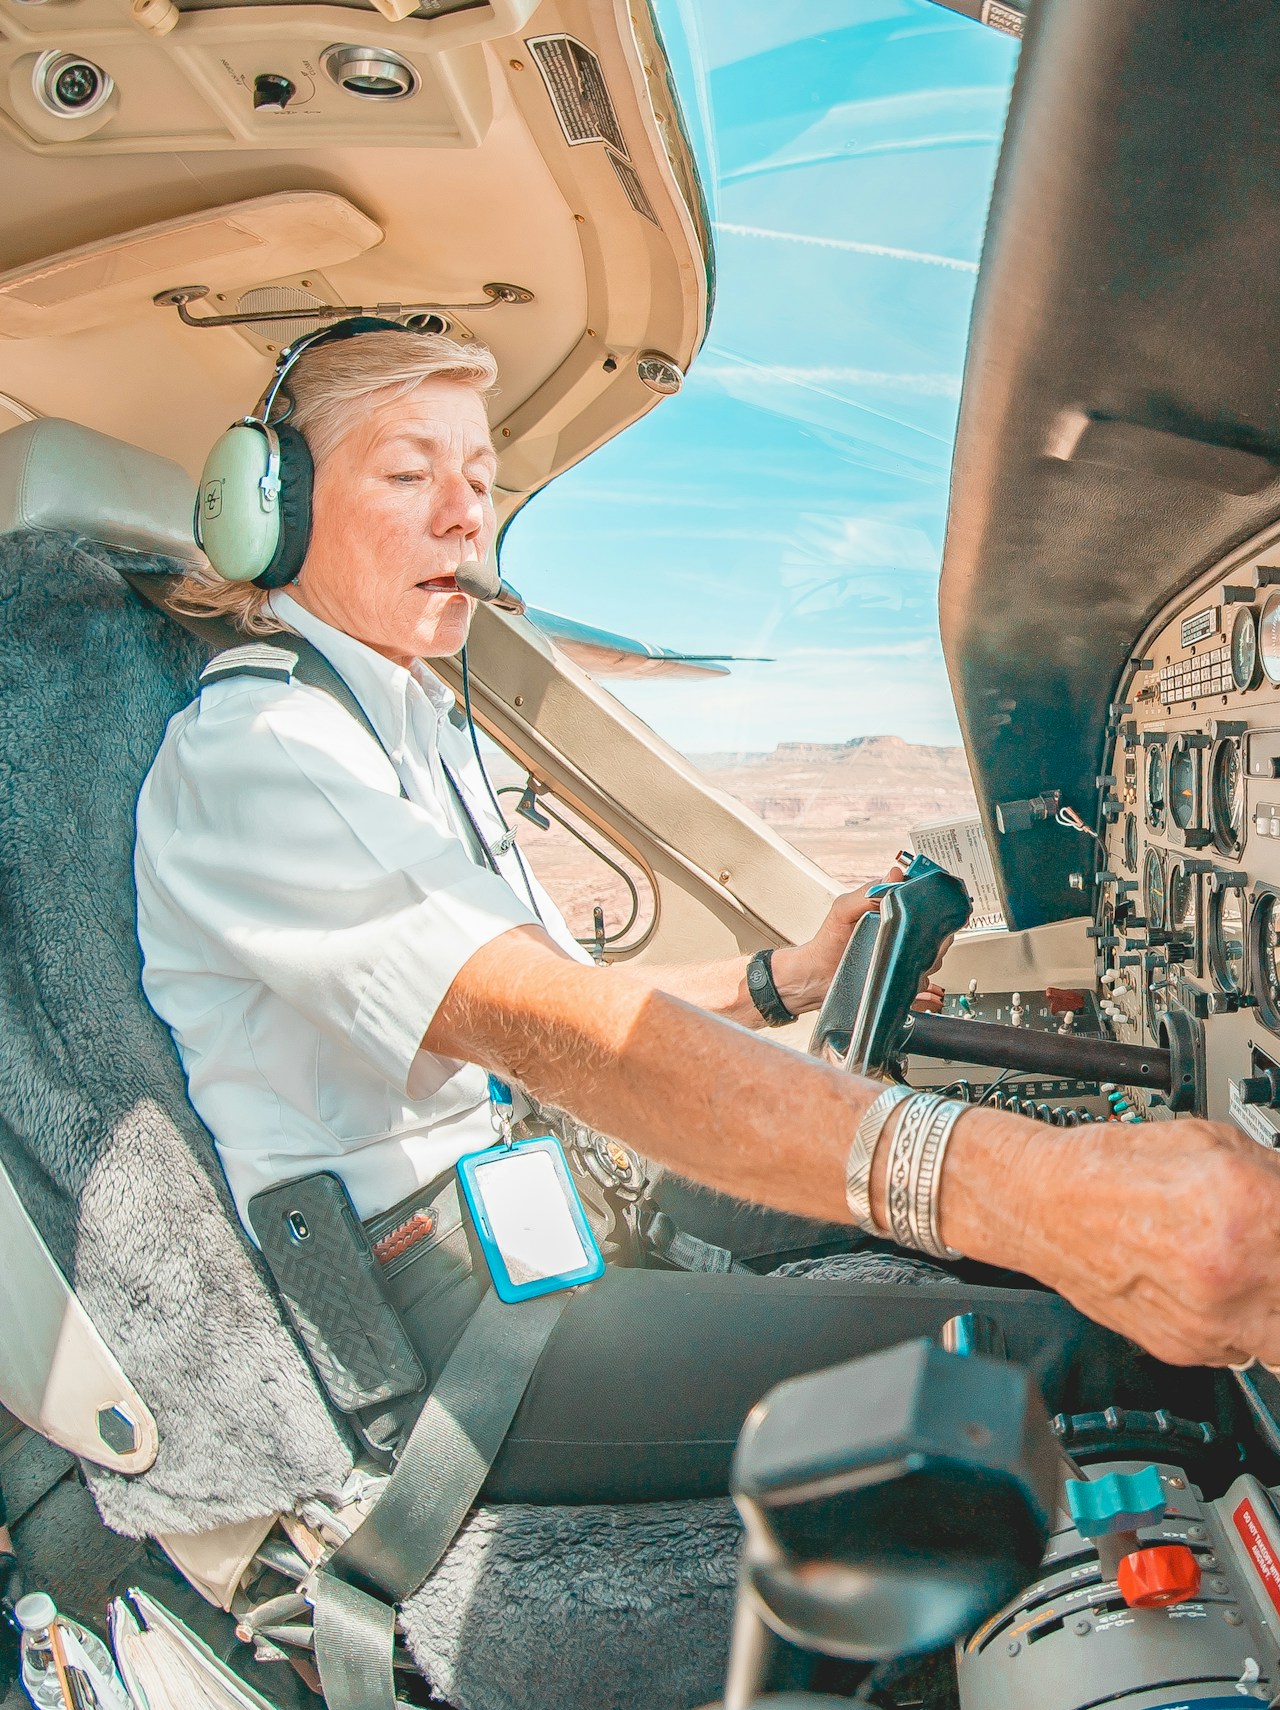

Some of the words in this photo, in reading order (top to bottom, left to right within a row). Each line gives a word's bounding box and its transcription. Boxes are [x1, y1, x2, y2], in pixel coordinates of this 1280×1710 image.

[1241, 1512, 1252, 1524] DO
[1246, 1521, 1259, 1537] NOT
[1252, 1534, 1274, 1566] TAKEOFF
[1070, 1565, 1099, 1578] RPM
[1098, 1611, 1128, 1624] LOW
[1095, 1618, 1135, 1632] IDLE
